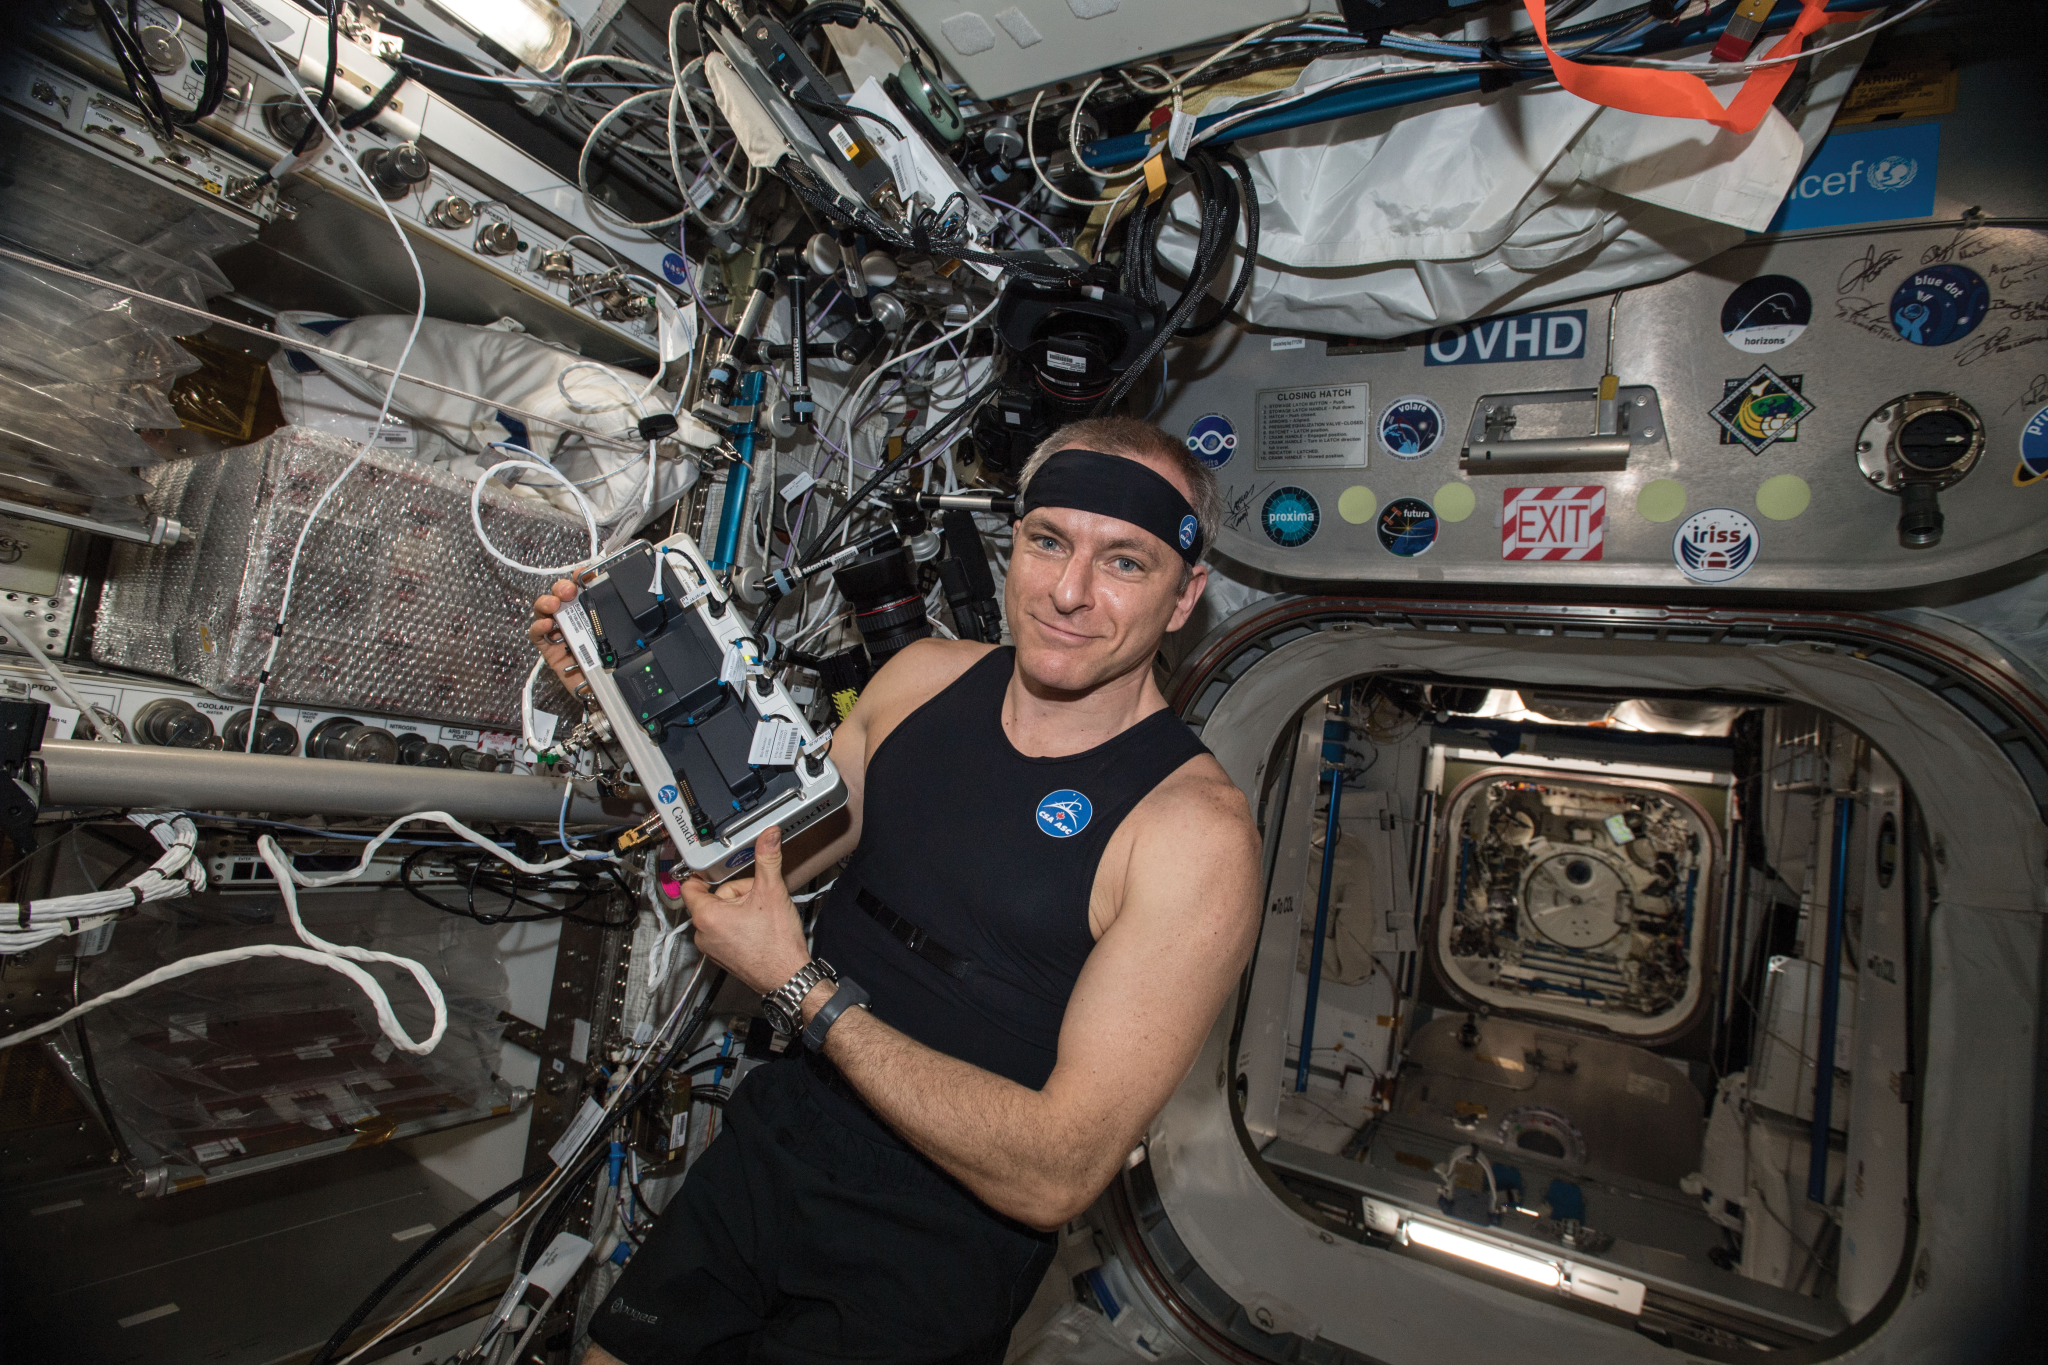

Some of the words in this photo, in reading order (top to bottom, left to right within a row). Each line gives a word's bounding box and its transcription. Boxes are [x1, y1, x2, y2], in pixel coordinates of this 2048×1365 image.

[95, 112, 114, 124] POWER
[252, 127, 271, 140] SUPPLY
[664, 260, 686, 278] NASA
[1915, 275, 1942, 287] blue
[1944, 282, 1964, 298] dot
[1430, 316, 1583, 362] OVHD
[1744, 337, 1786, 345] horizons
[1277, 392, 1316, 401] CLOSING
[1320, 389, 1351, 397] HATCH
[1398, 402, 1427, 412] volare
[1269, 511, 1314, 525] proxima
[1403, 509, 1429, 518] futura
[1518, 505, 1588, 543] EXIT
[1693, 525, 1741, 543] iriss
[197, 702, 234, 711] COOLANT
[672, 805, 698, 846] Canada
[781, 801, 832, 836] anada
[1039, 811, 1054, 823] CSA
[1054, 822, 1072, 835] ASC
